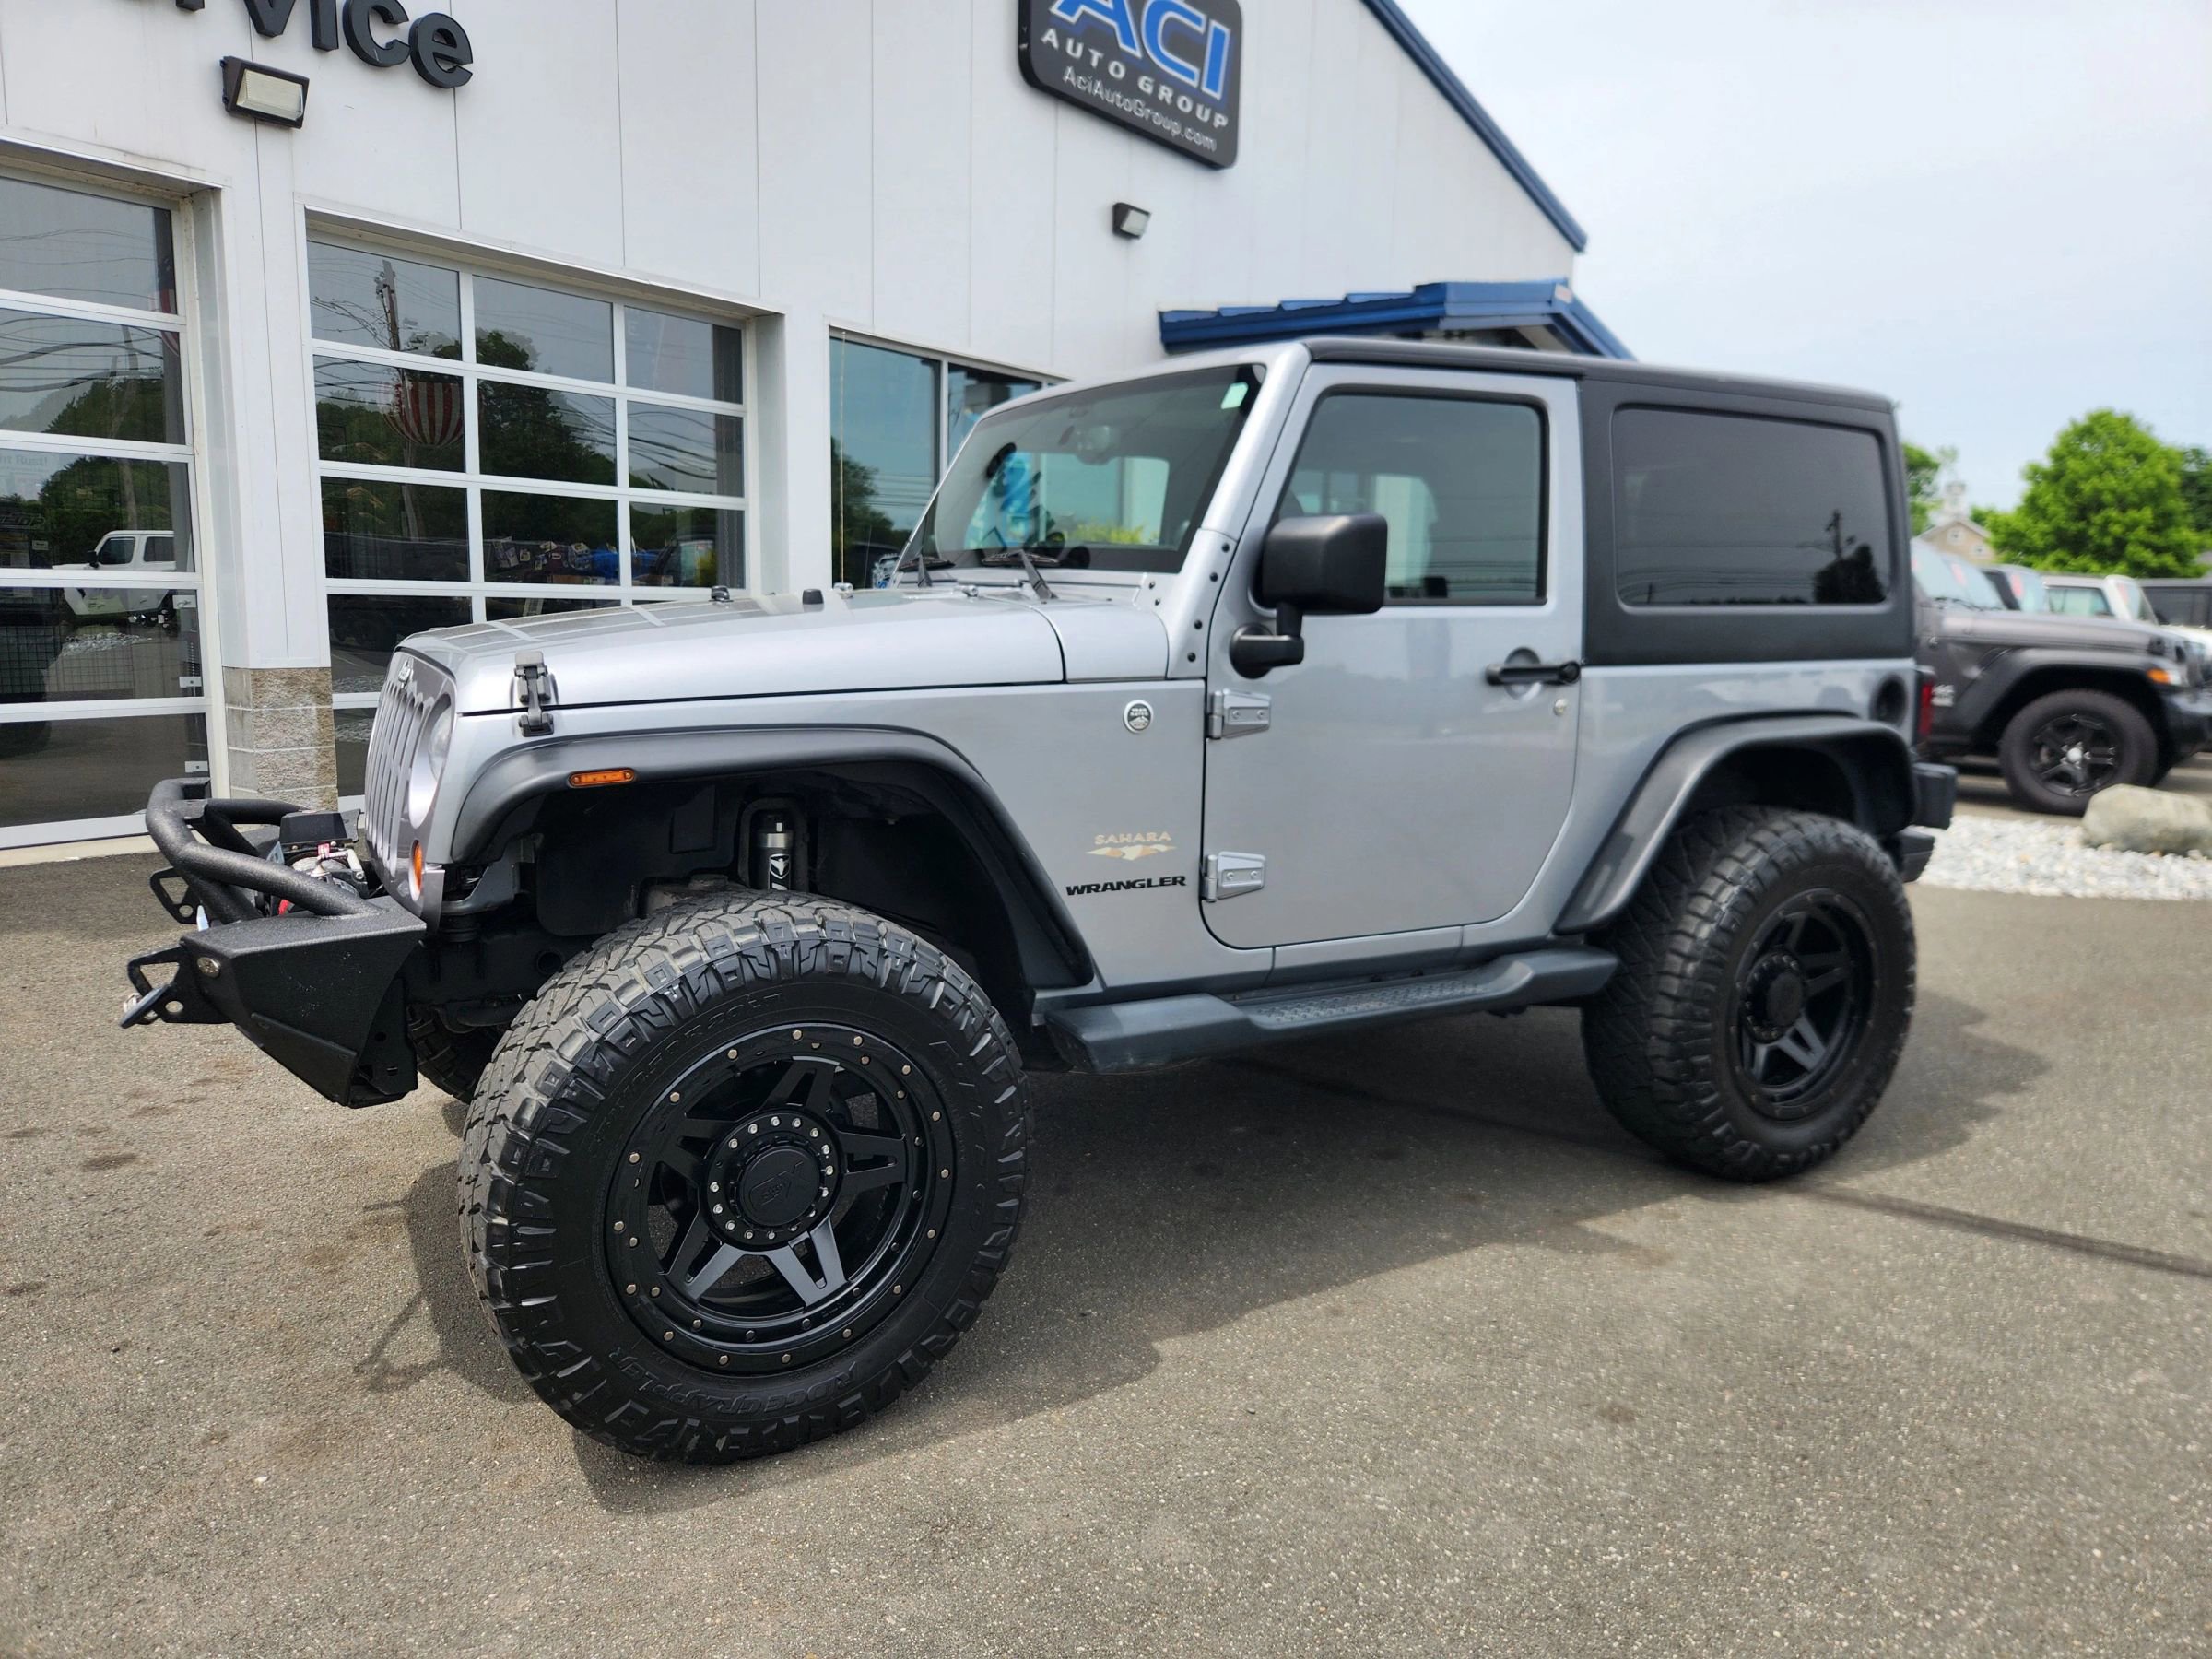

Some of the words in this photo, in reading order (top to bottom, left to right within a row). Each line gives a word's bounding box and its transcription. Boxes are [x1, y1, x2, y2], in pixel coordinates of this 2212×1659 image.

[1041, 27, 1127, 79] AUTO
[1137, 76, 1229, 129] GROUP
[1063, 65, 1218, 153] AciAutoGroup.com
[1094, 831, 1171, 845] SAHARA
[1065, 875, 1187, 896] WRANGLER
